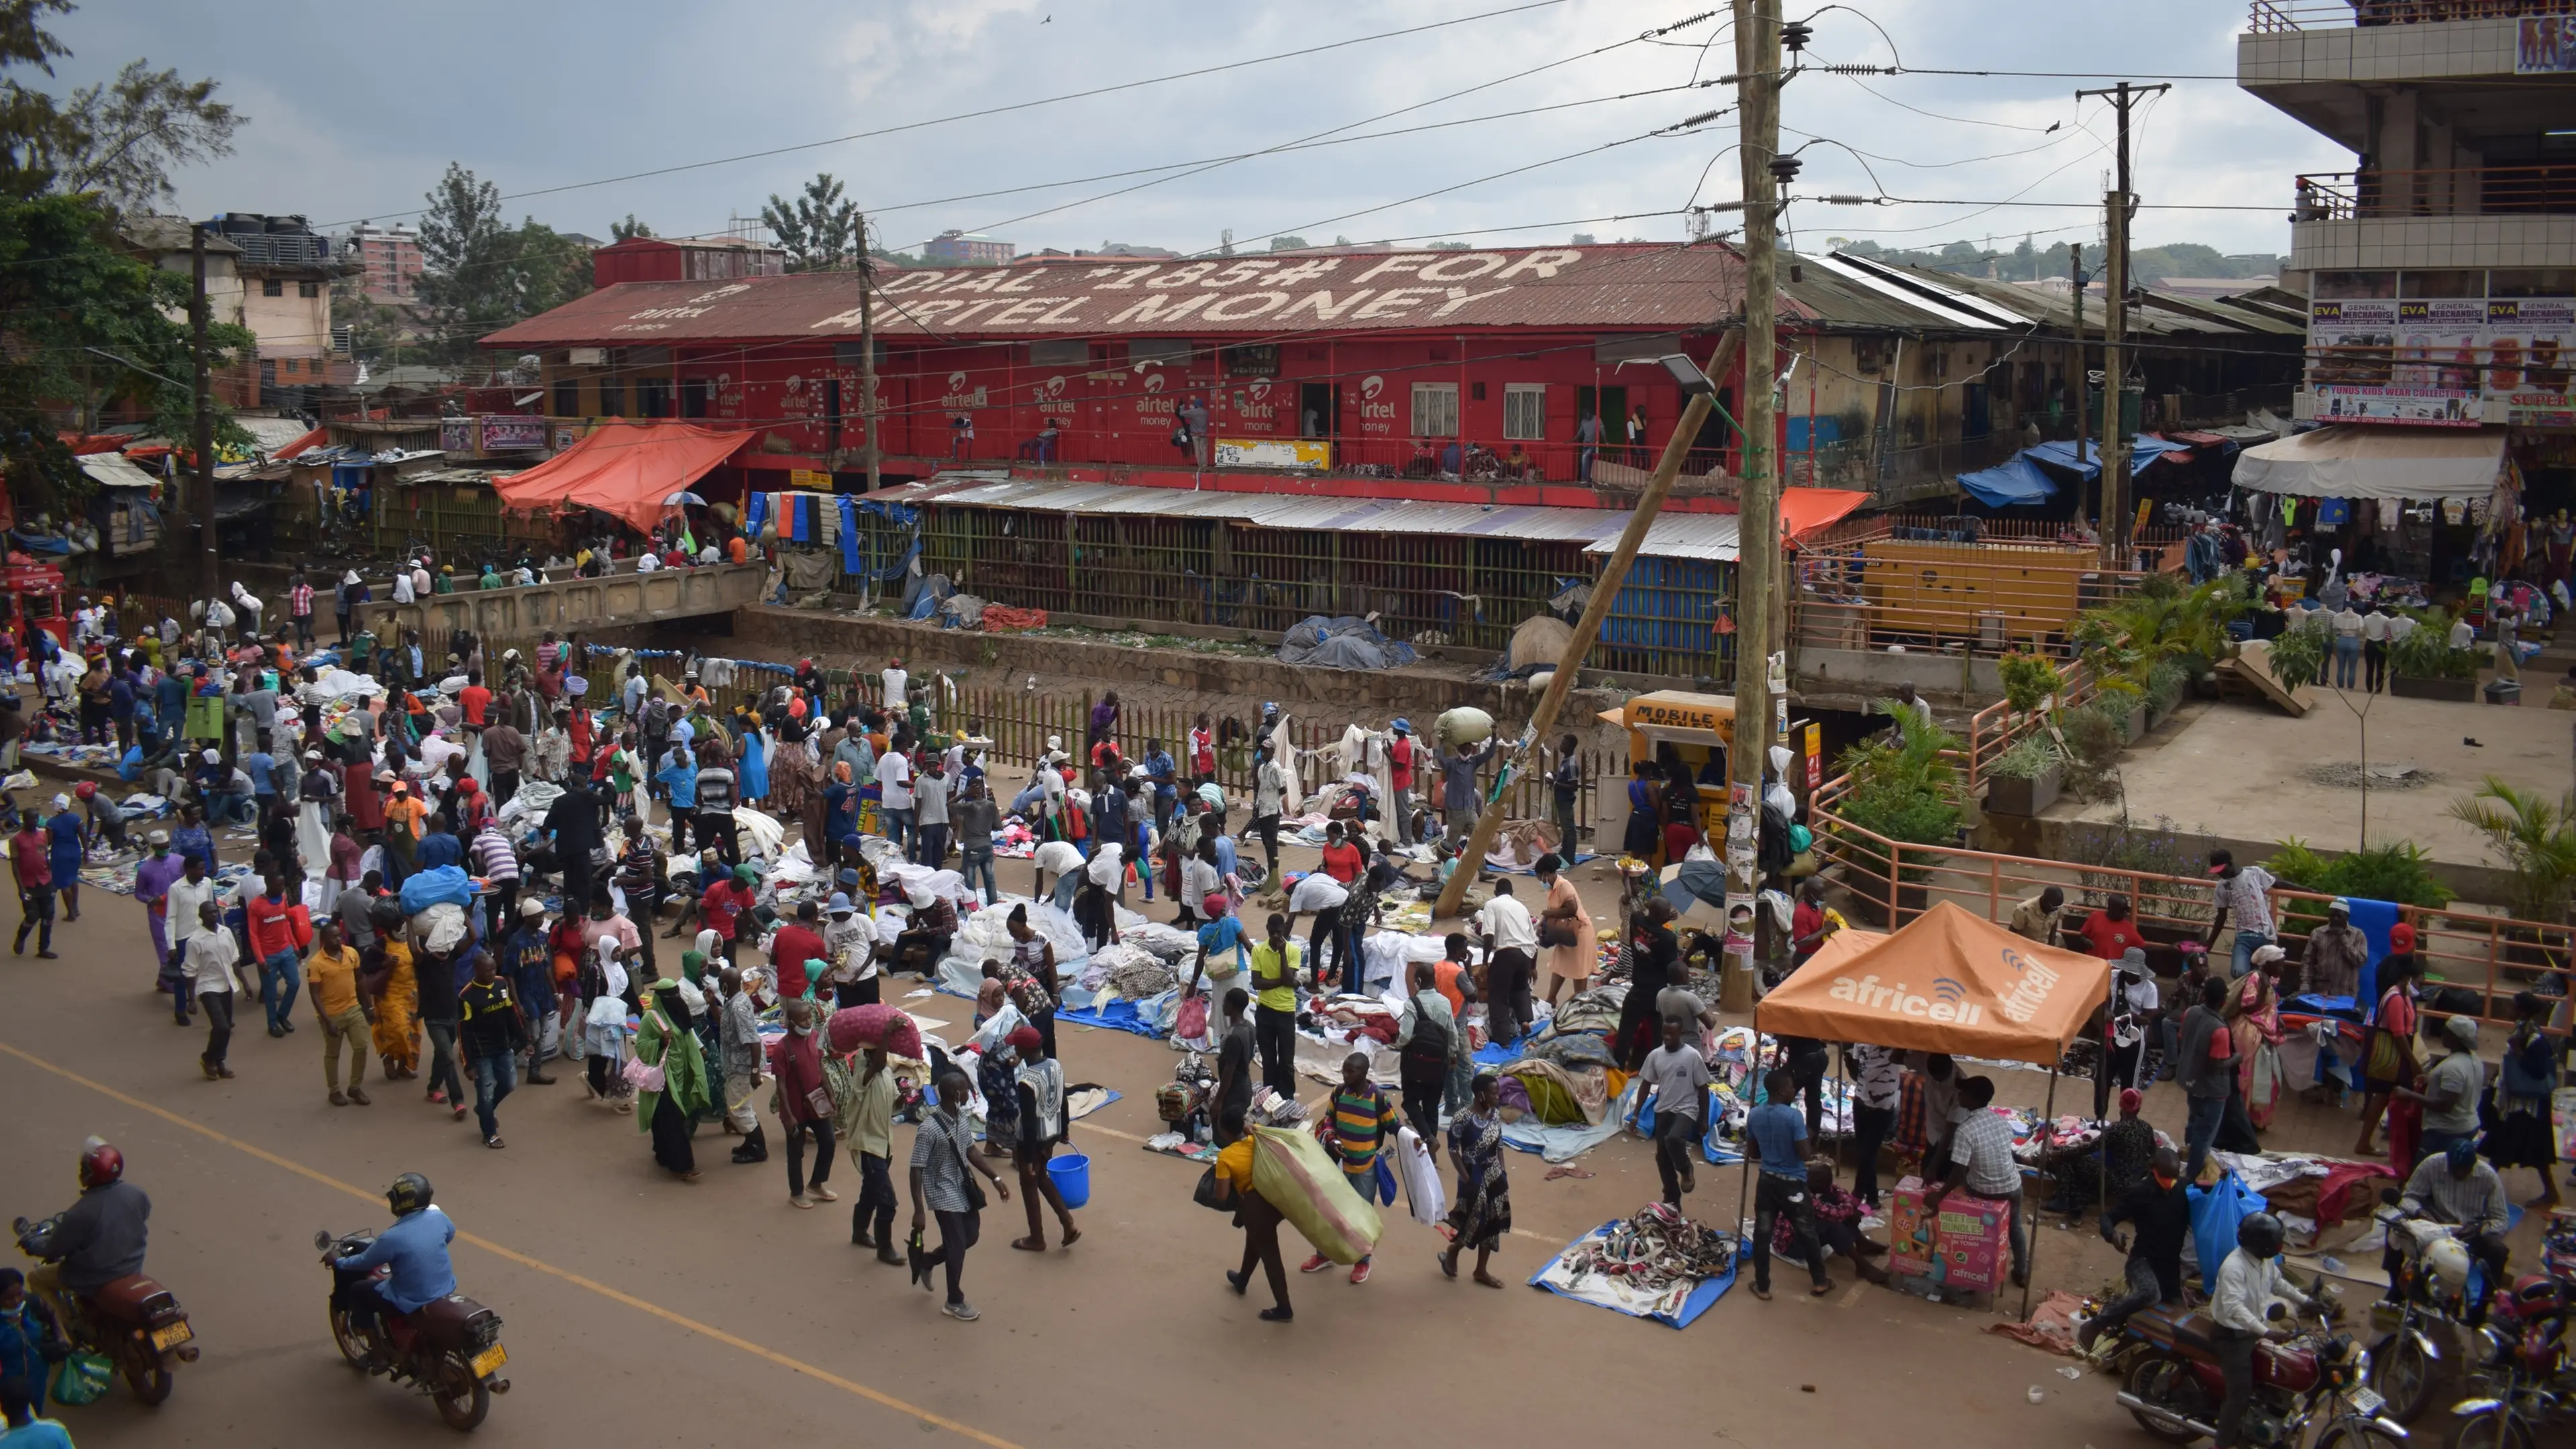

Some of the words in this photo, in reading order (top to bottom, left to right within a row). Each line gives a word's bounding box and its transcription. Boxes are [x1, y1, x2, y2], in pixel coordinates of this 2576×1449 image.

[870, 268, 1048, 295] DIAL
[1350, 250, 1582, 284] FOR
[810, 296, 1092, 329] AIRTEL
[1107, 286, 1515, 325] MONEY
[2314, 307, 2340, 315] EVA
[2400, 306, 2426, 315] EVA
[2429, 309, 2483, 318] MERCHANDISE
[2489, 306, 2516, 315] EVA
[2518, 309, 2575, 318] MERCHANDISE
[2331, 386, 2360, 395] YUNUS
[2362, 386, 2383, 396] KIDS
[2385, 388, 2411, 396] WEAR
[2413, 389, 2466, 398] COLLECTION
[780, 393, 810, 408] airtel
[857, 395, 890, 409] atel
[941, 392, 977, 408] airtel
[1136, 396, 1175, 413] airtel
[2510, 393, 2570, 406] SUPER
[1140, 417, 1171, 429] money
[1635, 706, 1714, 724] MOBILE
[856, 799, 870, 832] AFRICA
[1996, 953, 2060, 1022] africell
[1829, 975, 1982, 1026] africell
[1940, 1213, 1964, 1223] MEET
[1941, 1222, 1983, 1234] BUNDLES
[1952, 1268, 1988, 1283] africell
